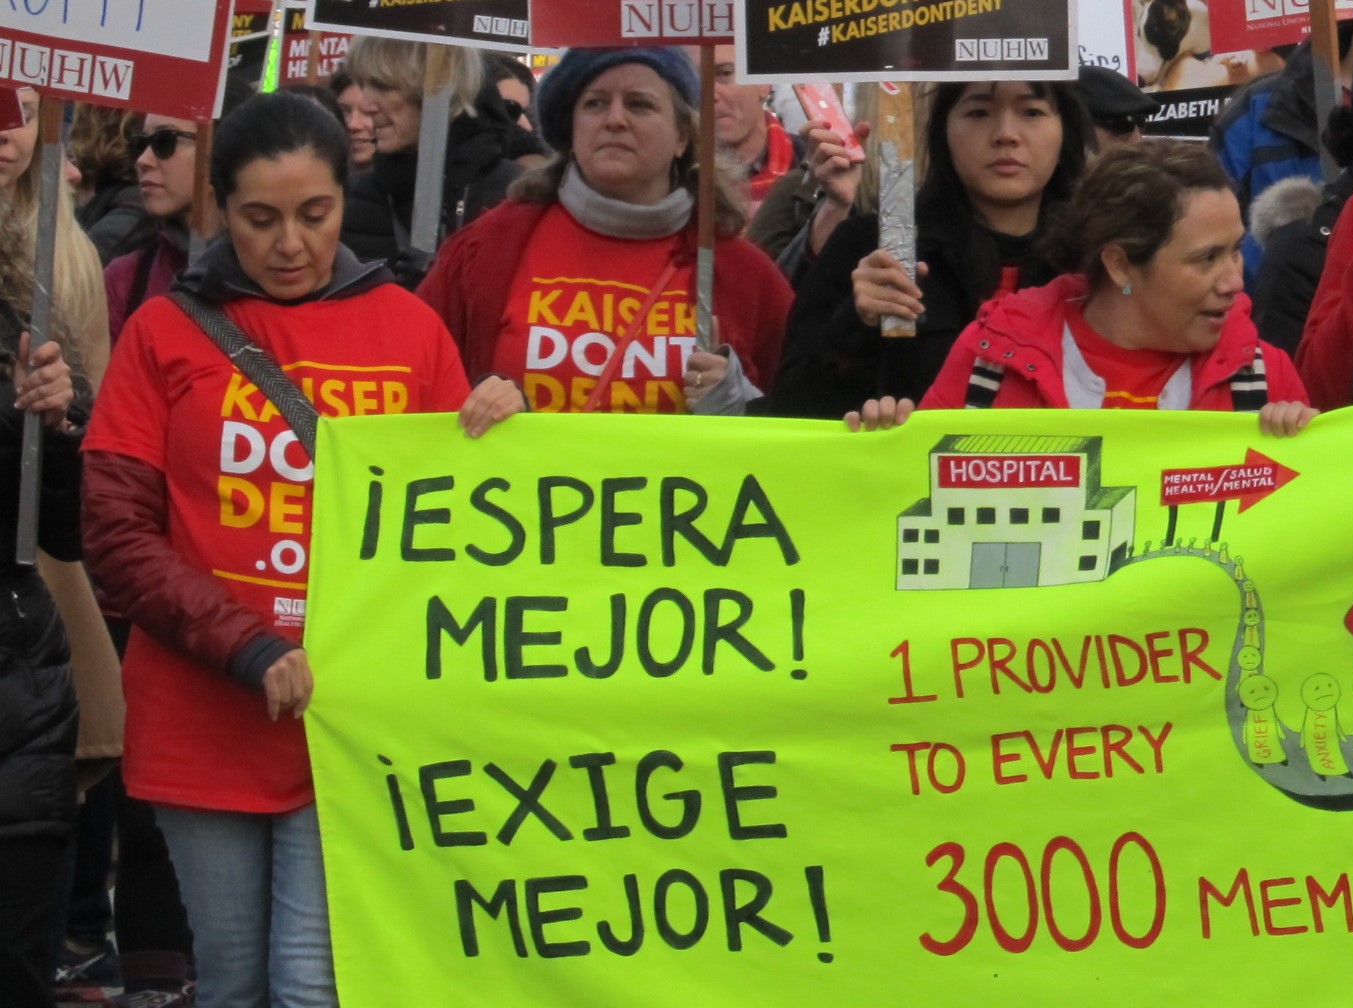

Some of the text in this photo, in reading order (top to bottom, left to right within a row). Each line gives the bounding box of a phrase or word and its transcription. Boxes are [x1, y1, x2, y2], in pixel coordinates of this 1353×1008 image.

[473, 15, 529, 37] NUH
[622, 0, 733, 37] NUH
[956, 39, 1048, 61] NUHW
[527, 290, 697, 337] KAISER
[526, 326, 697, 378] DONT
[221, 421, 314, 482] DO
[950, 460, 1073, 484] HOSPITAL
[1230, 467, 1272, 480] SALUD
[1164, 473, 1214, 484] MENTAL
[1165, 483, 1214, 496] HEALTH
[1223, 477, 1274, 491] MENTAL
[218, 475, 306, 534] DE
[425, 587, 808, 682] MEJOR!
[887, 627, 1224, 705] 1 PROVIDER
[891, 722, 1174, 795] TO EVERY
[1253, 716, 1270, 759] GRIEF
[1314, 711, 1336, 769] ANXIETY
[455, 864, 834, 963] MEJOR!
[919, 831, 1165, 957] 3000
